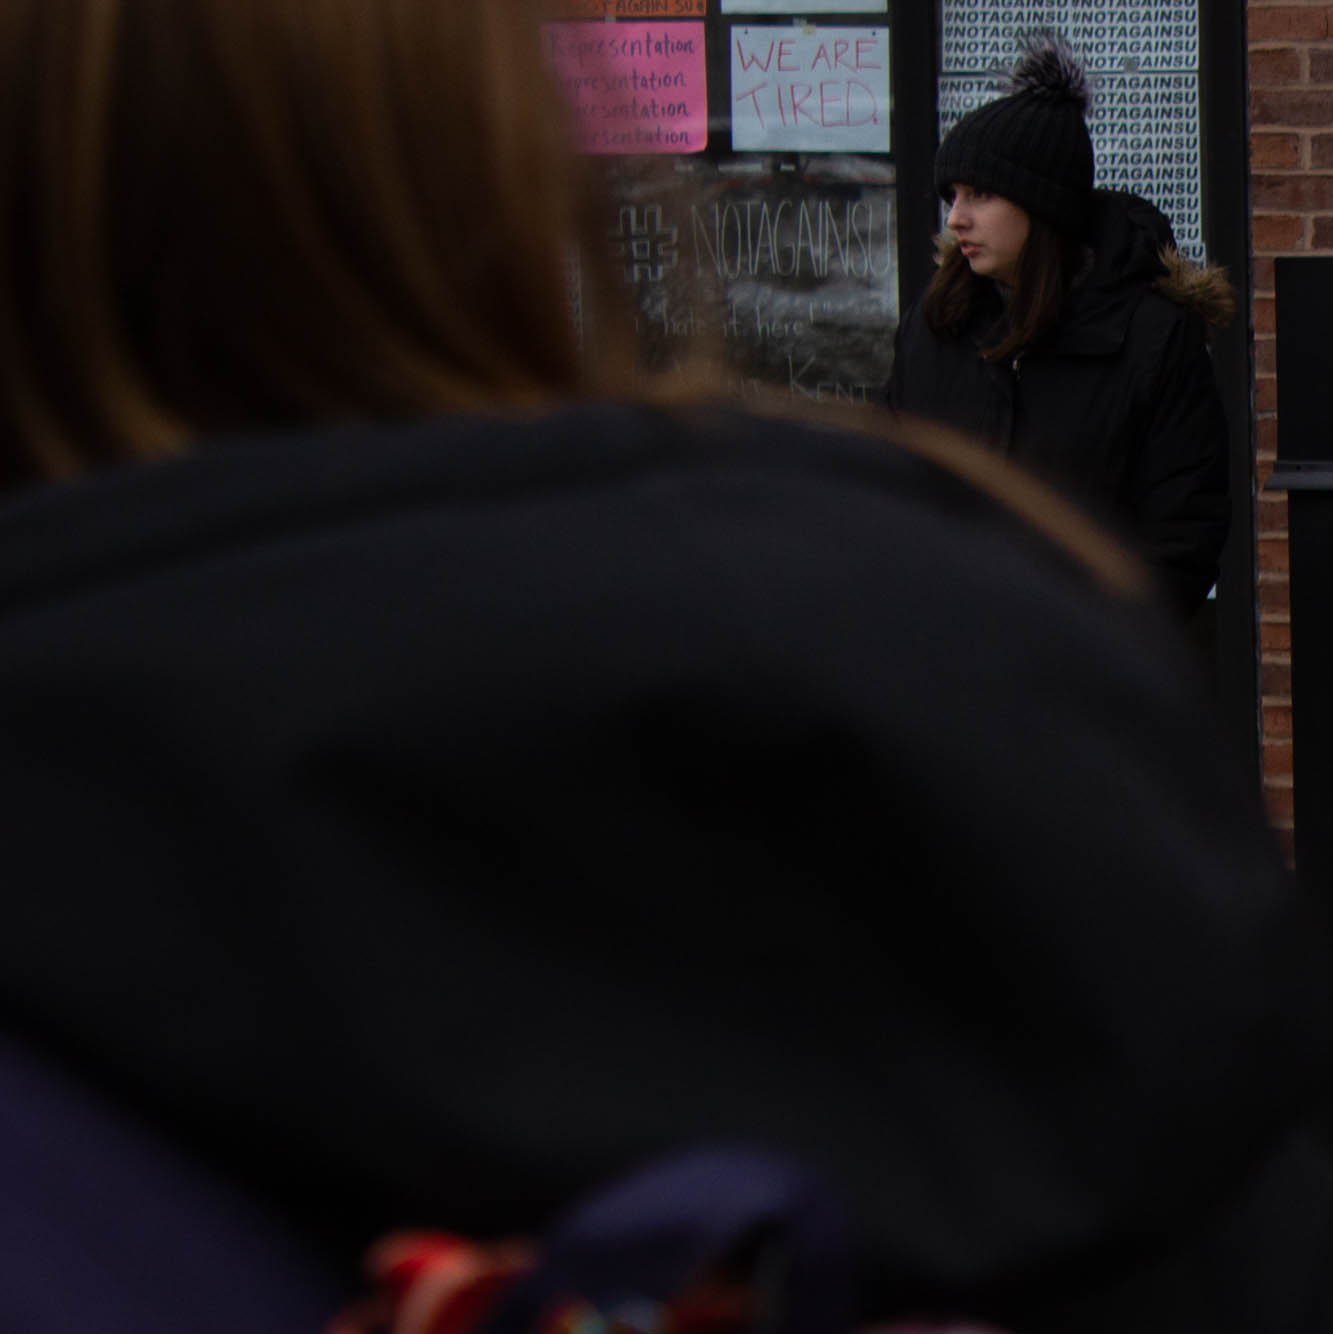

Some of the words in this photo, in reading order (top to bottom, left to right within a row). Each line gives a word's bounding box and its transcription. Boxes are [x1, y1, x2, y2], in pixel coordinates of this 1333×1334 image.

[944, 11, 1068, 23] #NOTAGAINSU
[1072, 11, 1196, 23] #NOTAGAINSU
[1072, 26, 1196, 38] #NOTAGAINSU
[1073, 41, 1196, 53] #NOTAGAINSU
[737, 39, 800, 72] WE
[811, 39, 882, 71] ARE
